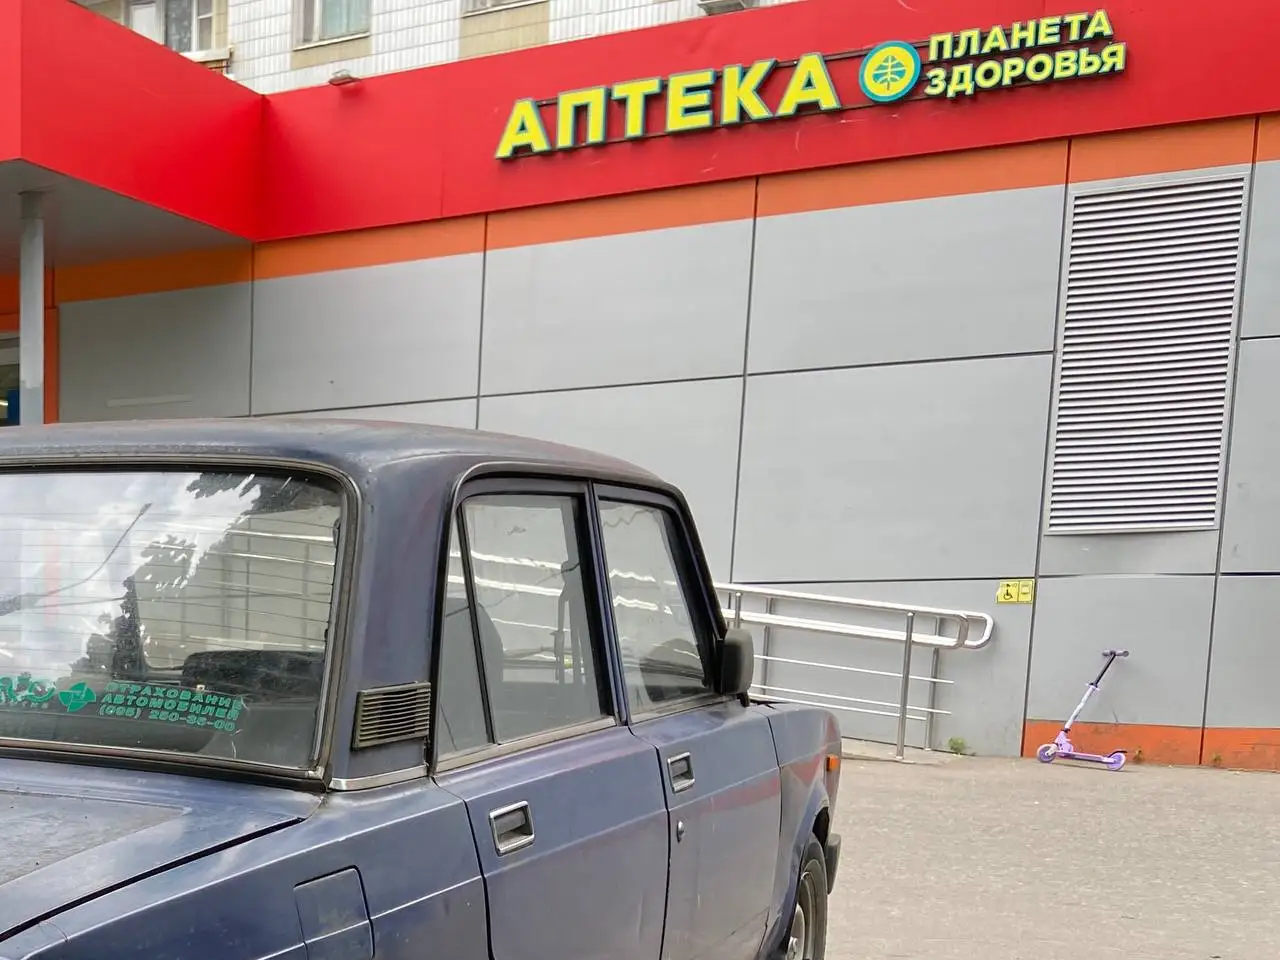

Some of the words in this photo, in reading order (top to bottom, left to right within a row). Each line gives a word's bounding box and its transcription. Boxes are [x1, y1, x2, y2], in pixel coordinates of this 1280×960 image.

[928, 8, 1114, 61] ПЛАНЕТА
[923, 41, 1127, 98] ЗДОРОВЬЯ
[494, 52, 843, 159] АПТЕКА
